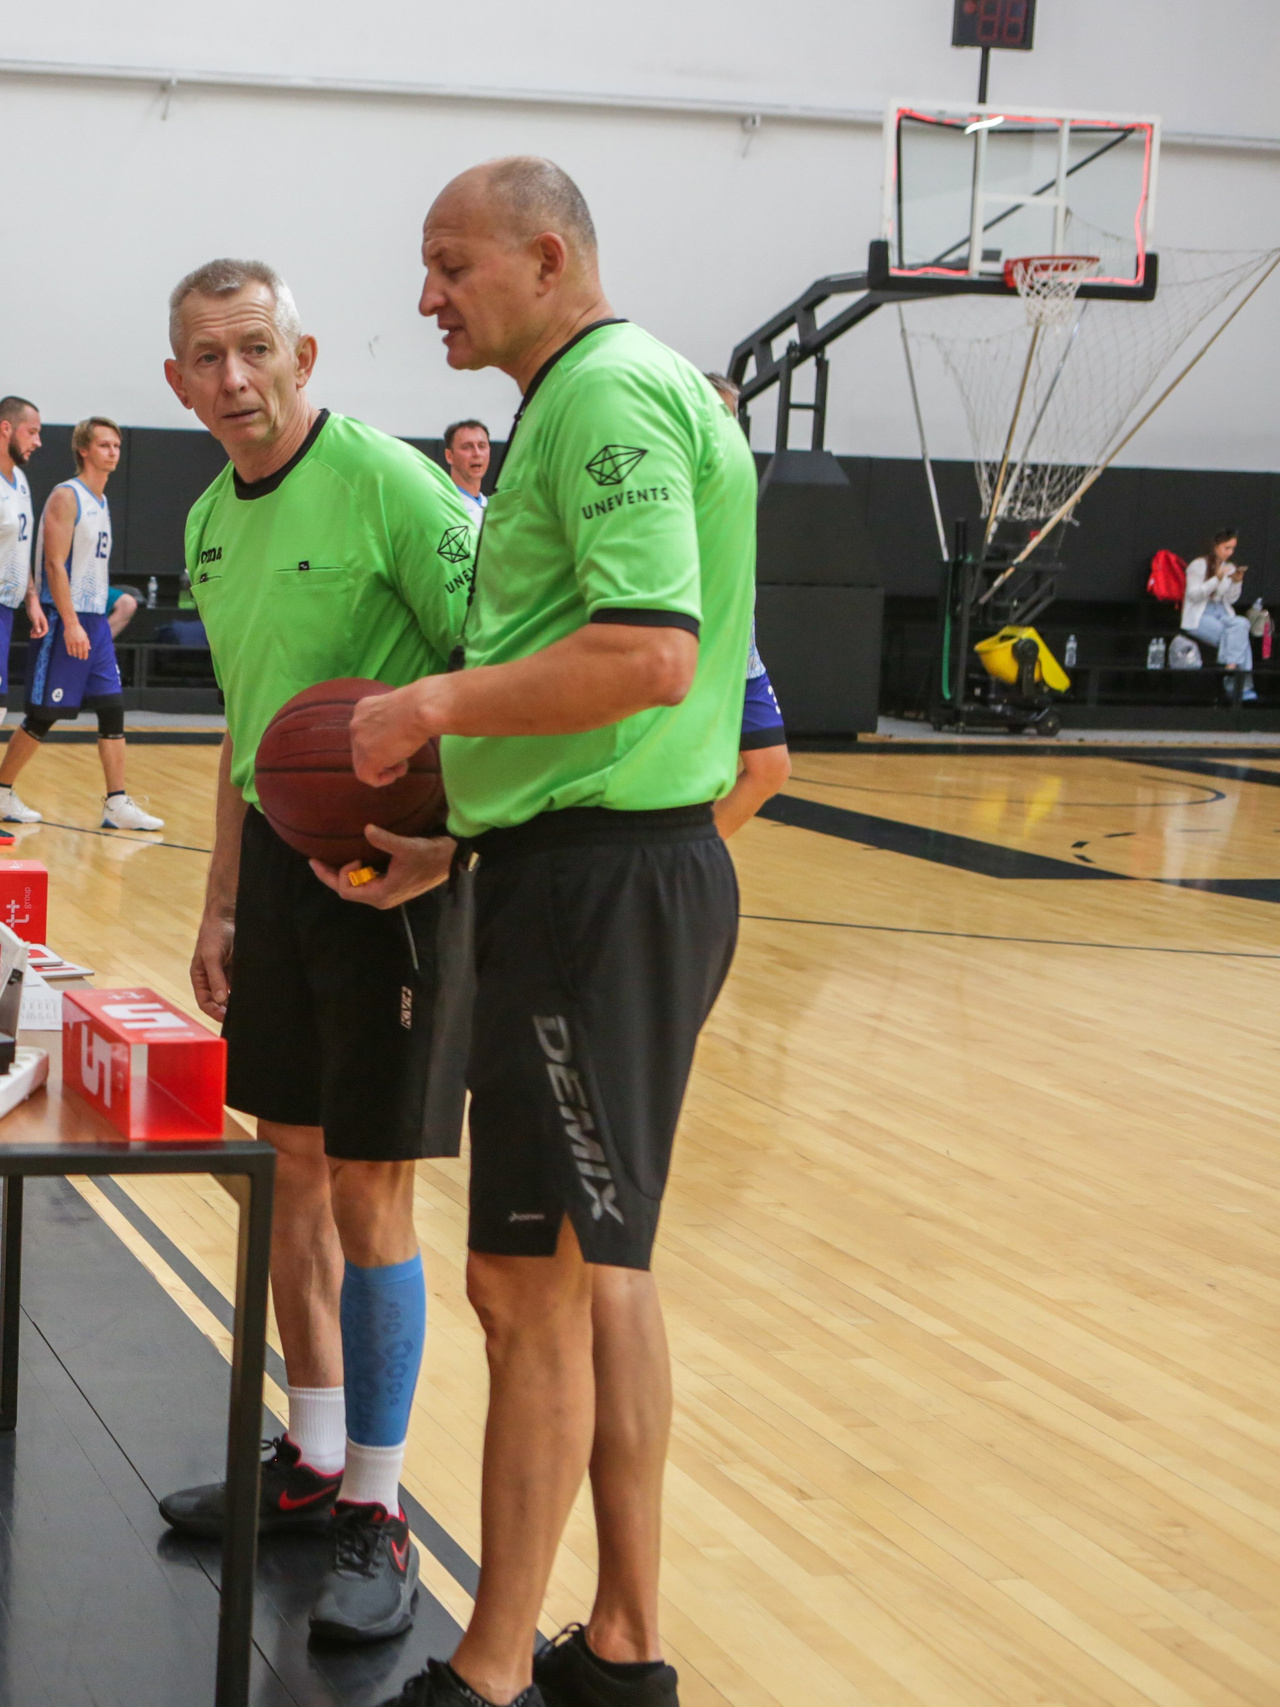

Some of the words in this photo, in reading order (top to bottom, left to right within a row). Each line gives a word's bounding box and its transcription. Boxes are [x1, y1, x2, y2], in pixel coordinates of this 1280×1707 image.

[581, 487, 670, 520] UNEVENTS
[23, 886, 32, 910] group
[531, 1013, 624, 1226] DEMIX
